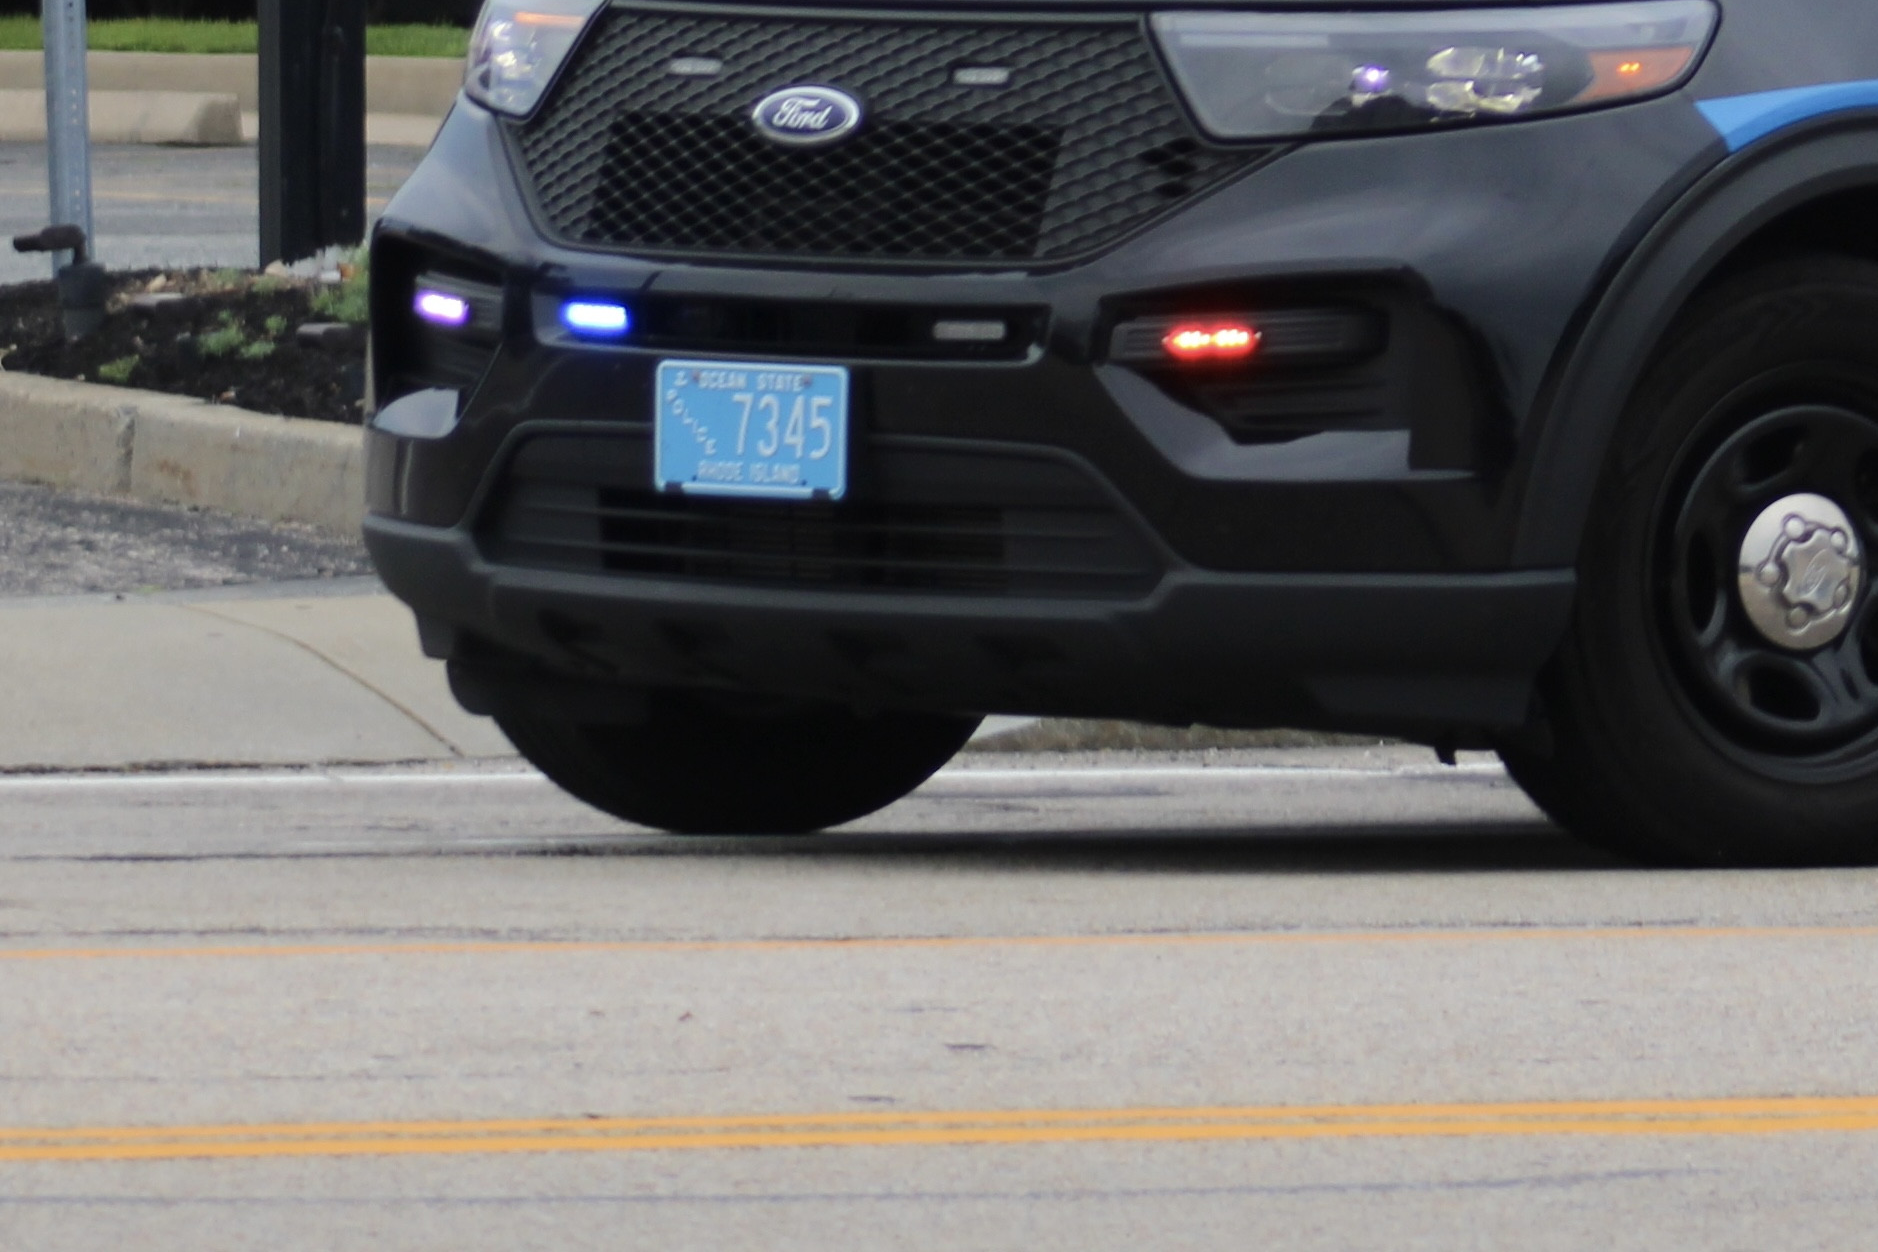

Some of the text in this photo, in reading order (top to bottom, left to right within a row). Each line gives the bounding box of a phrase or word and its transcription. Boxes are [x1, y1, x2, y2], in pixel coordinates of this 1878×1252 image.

[773, 98, 830, 129] Ford
[758, 373, 804, 391] STATE
[733, 393, 832, 459] 7345
